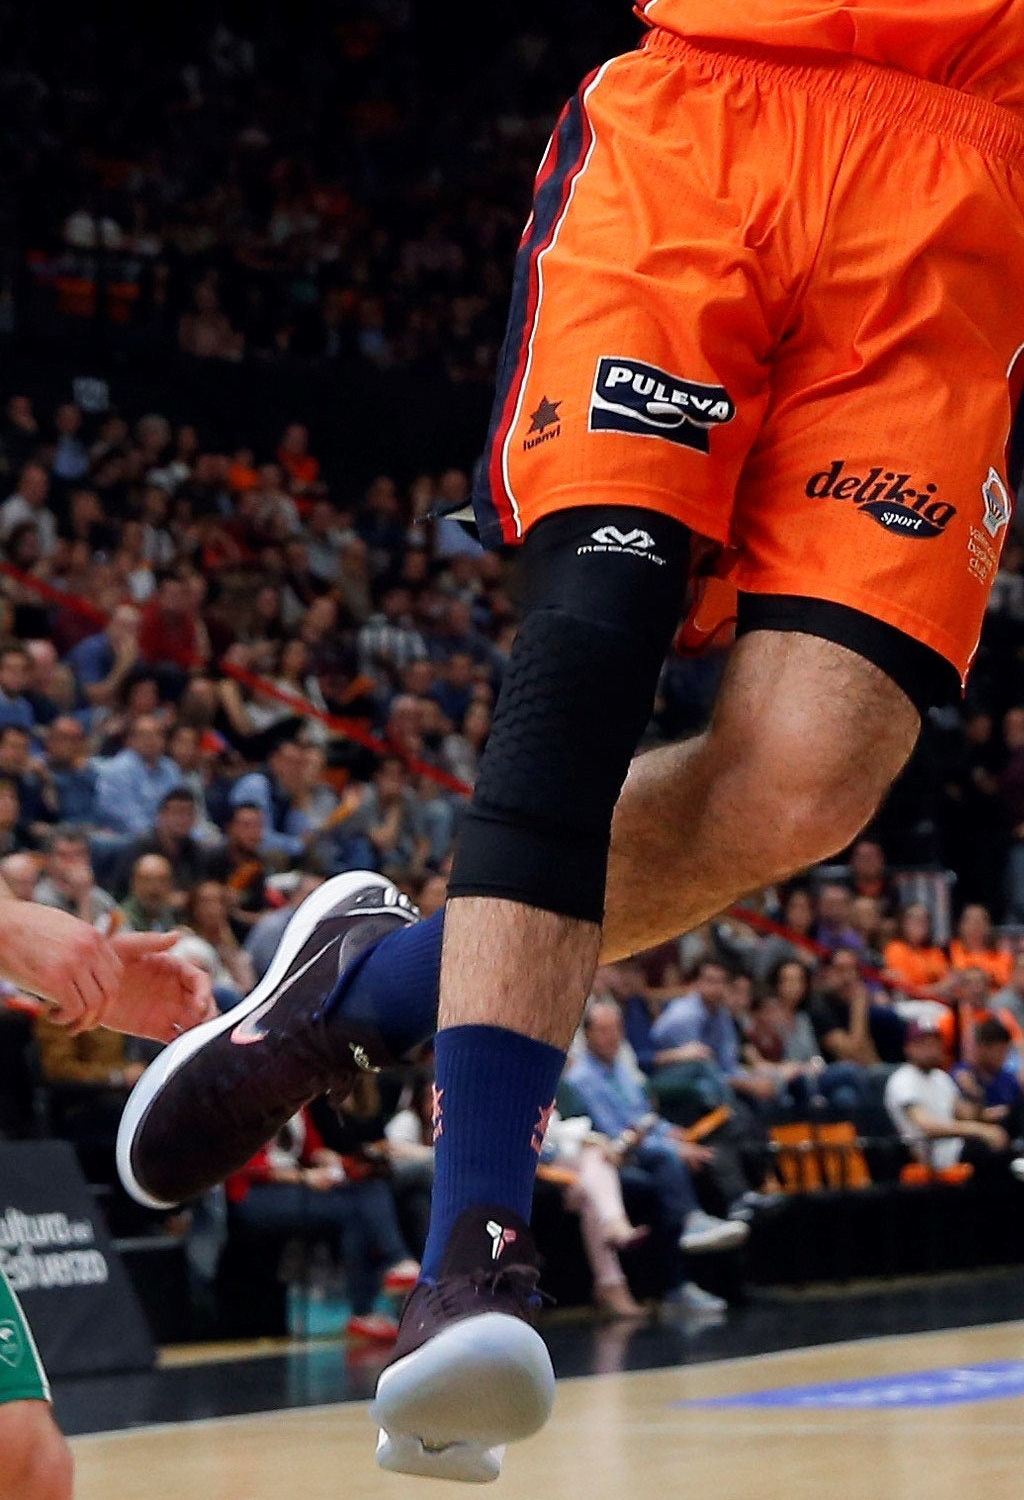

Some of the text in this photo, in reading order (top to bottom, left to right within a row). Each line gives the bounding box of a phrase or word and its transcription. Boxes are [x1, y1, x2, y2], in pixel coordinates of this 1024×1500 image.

[604, 366, 730, 421] PULEVA
[523, 424, 561, 452] luanvi
[805, 460, 958, 528] delikia
[880, 510, 923, 531] sport
